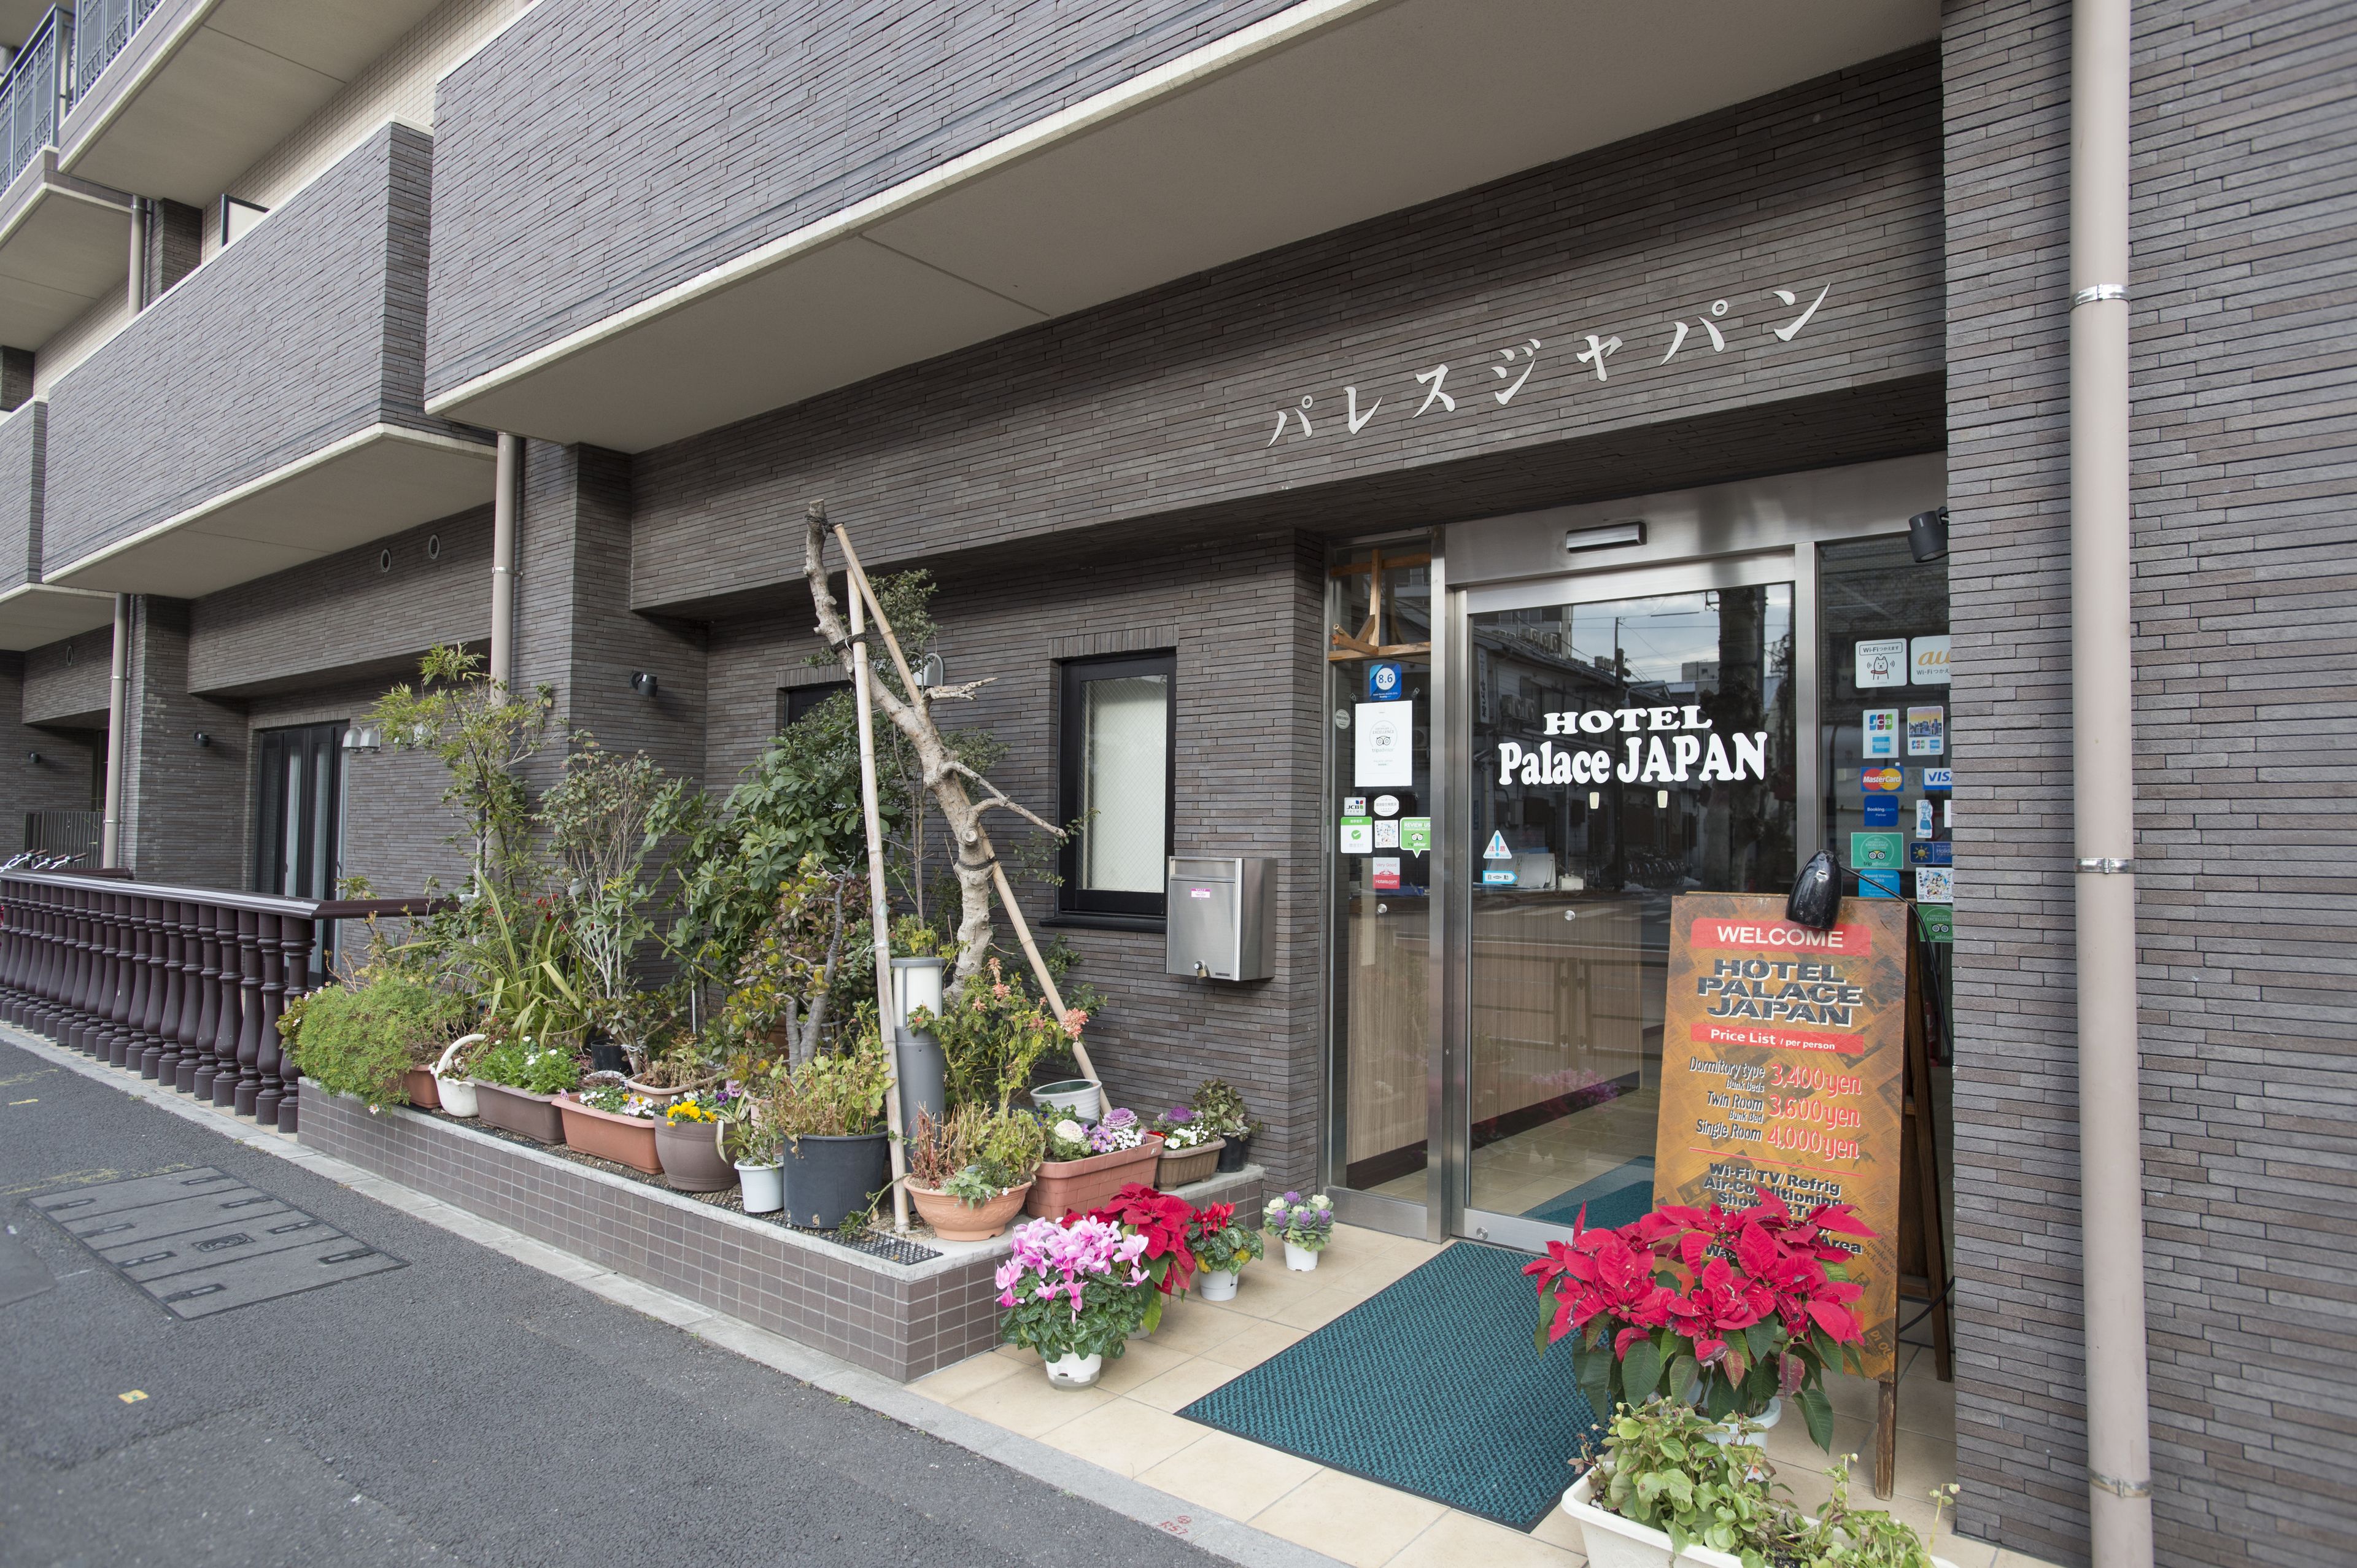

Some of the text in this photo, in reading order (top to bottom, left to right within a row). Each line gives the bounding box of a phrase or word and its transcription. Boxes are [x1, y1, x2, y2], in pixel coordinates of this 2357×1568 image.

[1268, 282, 1830, 448] パレスジャパン
[1918, 651, 1950, 666] au
[1379, 674, 1393, 683] 8.6
[1544, 705, 1713, 735] HOTEL
[1498, 732, 1768, 786] Palace JAPAN
[1928, 771, 1952, 781] VIS
[1717, 925, 1843, 948] WELCOME
[1714, 959, 1846, 985] HOTEL
[1697, 977, 1863, 1006] PALACE
[1706, 997, 1852, 1027] JAPAN
[1711, 1029, 1745, 1042] Price
[1749, 1032, 1776, 1045] List
[1803, 1041, 1835, 1050] person
[1689, 1056, 1741, 1078] Dormitory
[1742, 1063, 1765, 1081] type
[1726, 1078, 1765, 1092] Bunk Beds
[1708, 1091, 1730, 1108] Twin
[1732, 1094, 1764, 1112] Room
[1728, 1110, 1763, 1124] Bunk Bed
[1696, 1119, 1728, 1140] Single
[1730, 1122, 1762, 1141] Room
